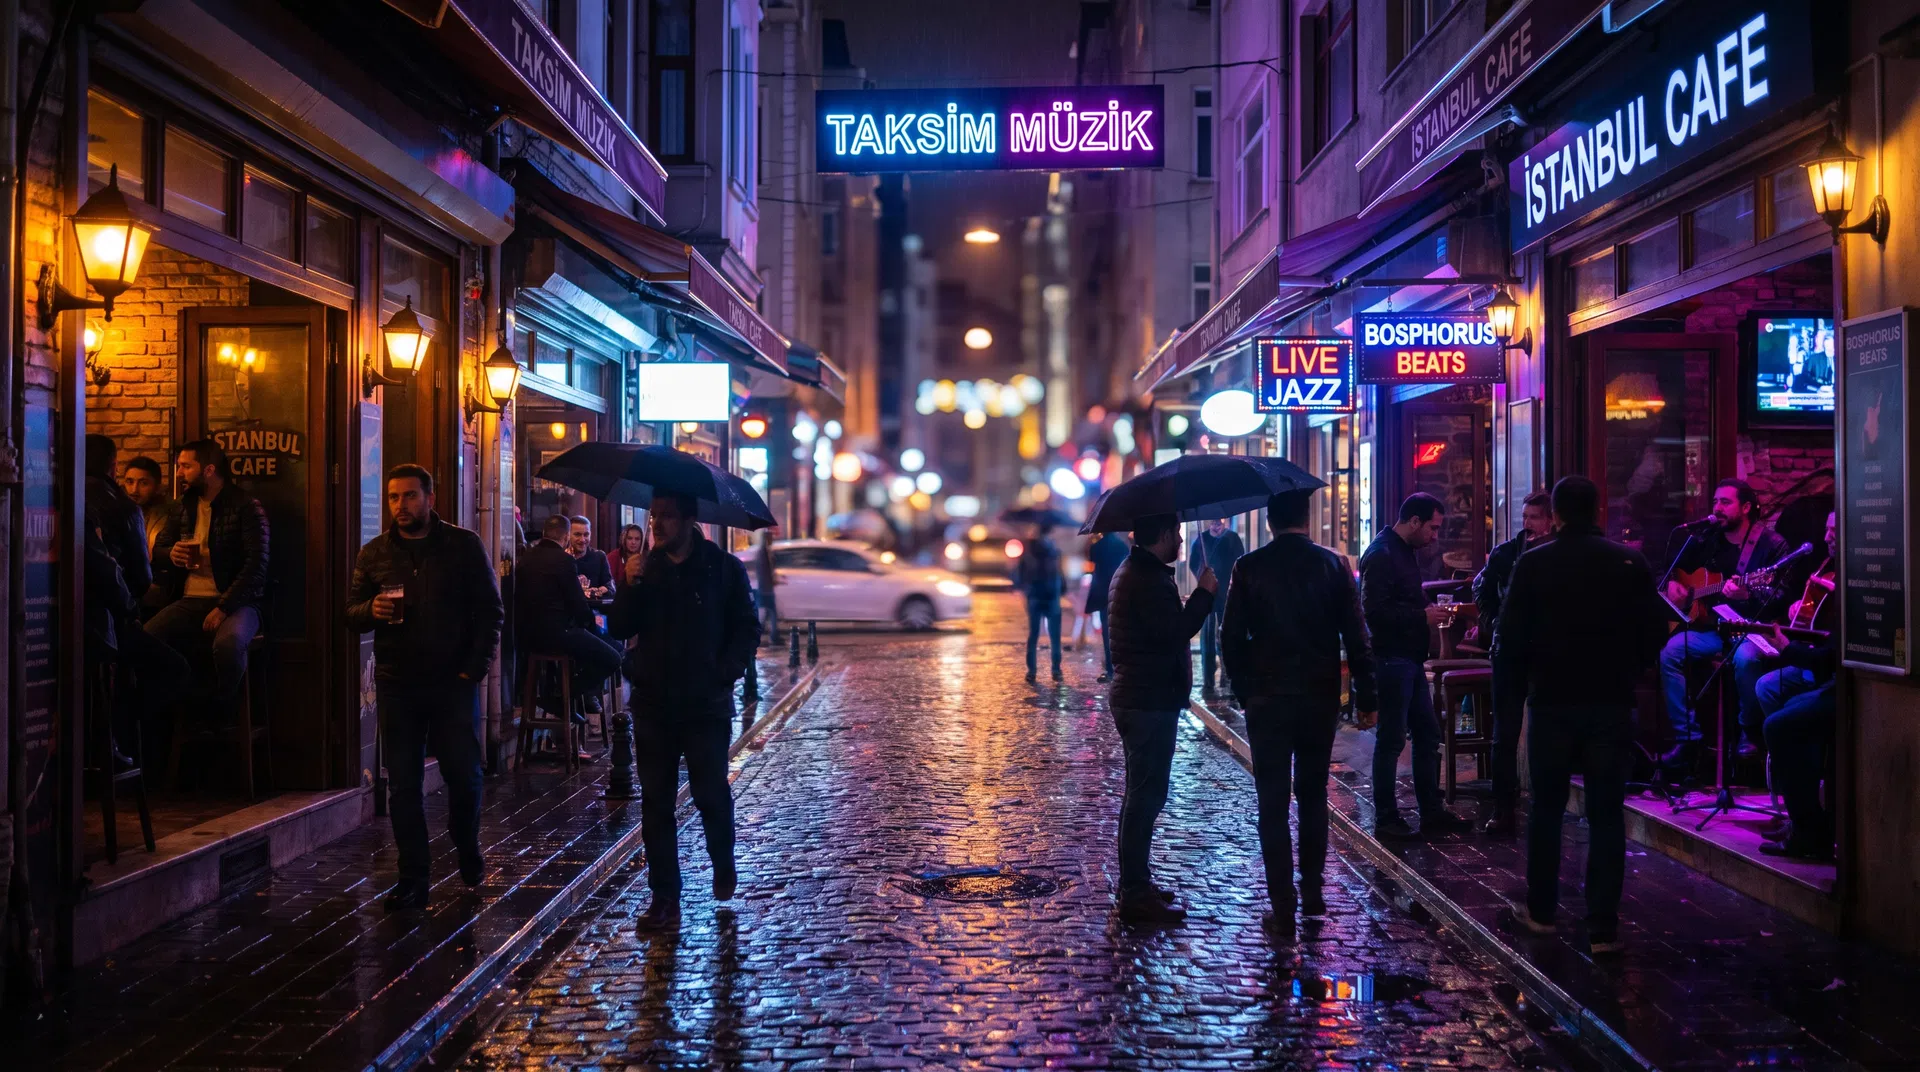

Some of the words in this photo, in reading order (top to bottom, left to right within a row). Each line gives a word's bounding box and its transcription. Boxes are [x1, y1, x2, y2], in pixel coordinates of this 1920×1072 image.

[511, 16, 572, 119] TAKSİM
[576, 92, 617, 167] MÜZİK
[1411, 71, 1481, 163] İSTANBUL
[1484, 18, 1533, 95] CAFE
[826, 102, 996, 155] TAKSİM
[1010, 100, 1154, 153] MÜZİK
[1524, 95, 1657, 229] İSTANBUL
[1665, 12, 1769, 146] CAFE
[1364, 322, 1497, 346] BOSPHORUS
[1846, 325, 1901, 351] BOSPHORUS
[1272, 346, 1338, 374] LIVE
[1397, 351, 1466, 374] BEATS
[1859, 347, 1888, 366] BEATS
[1267, 378, 1342, 406] JAZZ
[207, 431, 300, 455] STANBUL
[230, 457, 277, 475] CAFE
